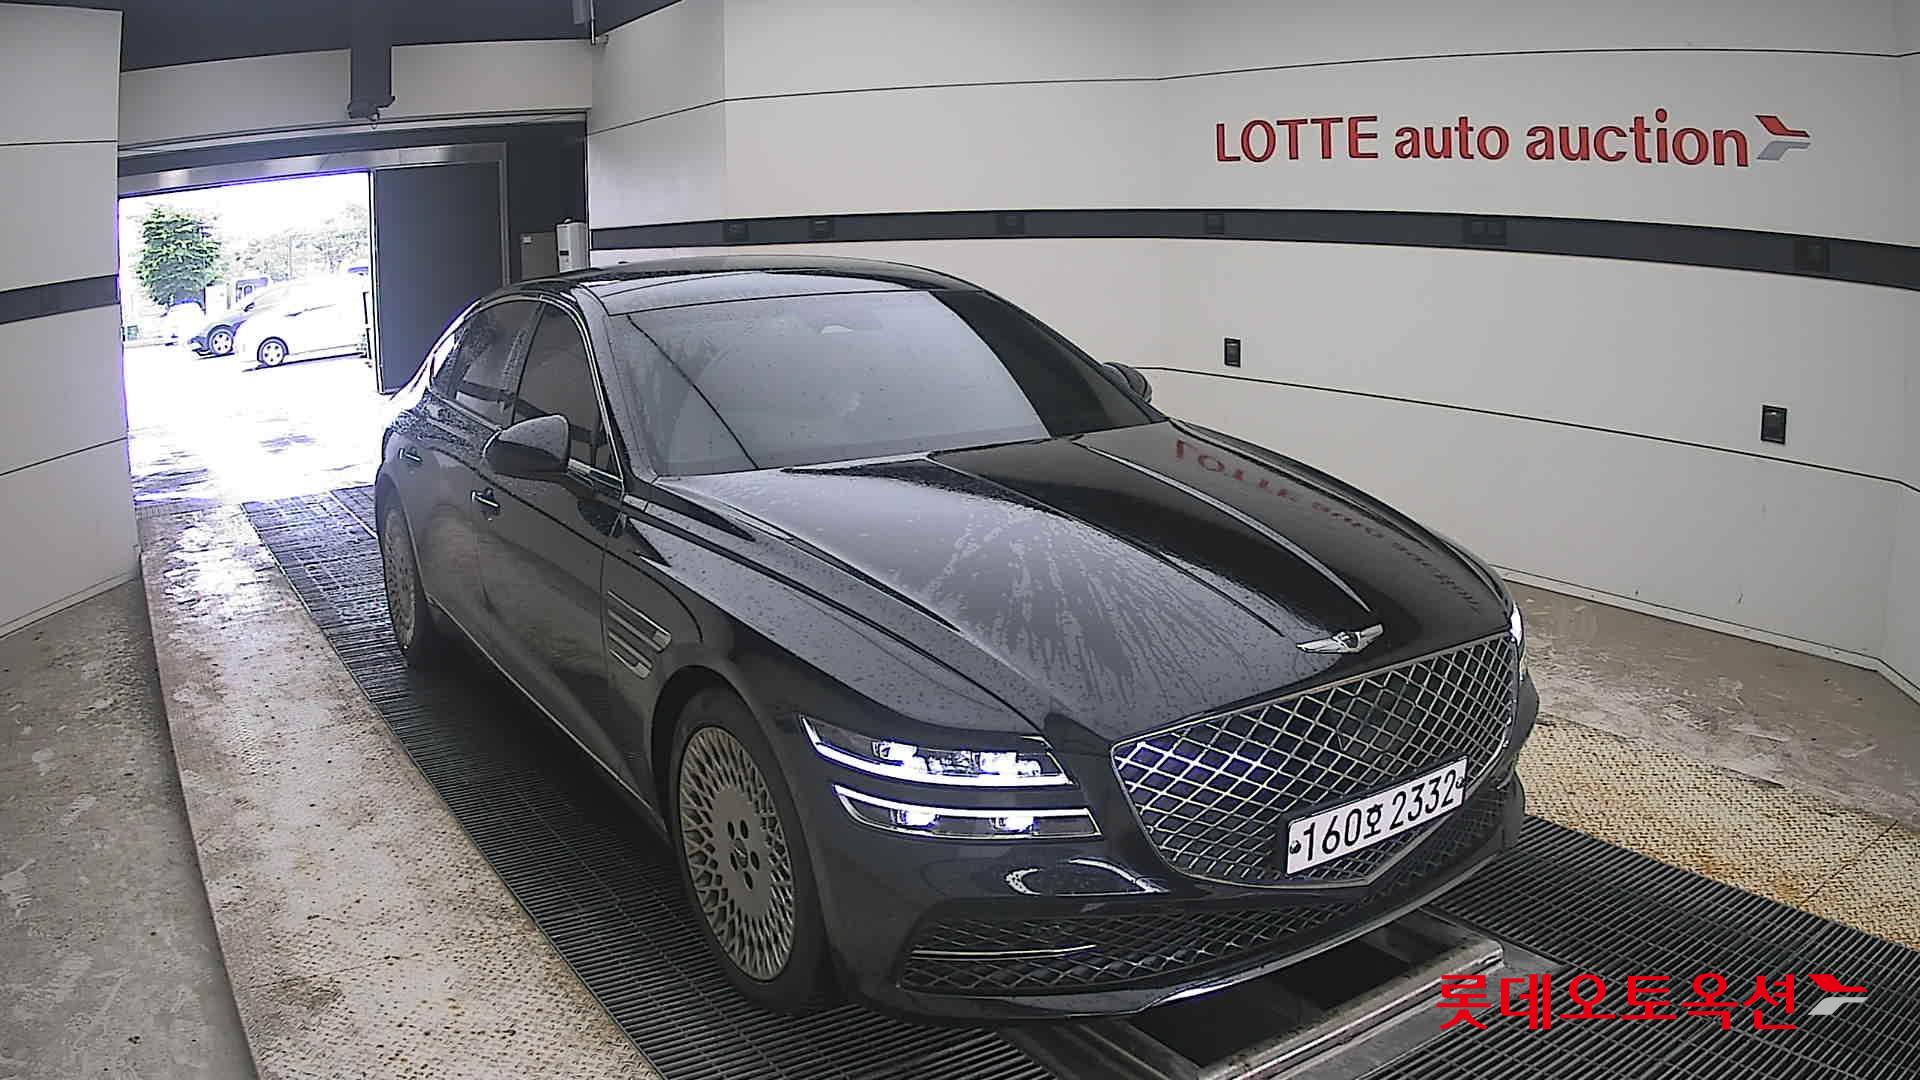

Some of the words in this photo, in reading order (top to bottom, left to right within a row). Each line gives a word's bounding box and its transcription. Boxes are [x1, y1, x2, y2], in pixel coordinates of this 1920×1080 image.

[1215, 115, 1379, 163] LOTTE
[1394, 115, 1510, 161] auto
[1525, 108, 1751, 168] auction
[1302, 803, 1384, 861] 160호
[1389, 768, 1457, 831] 2332
